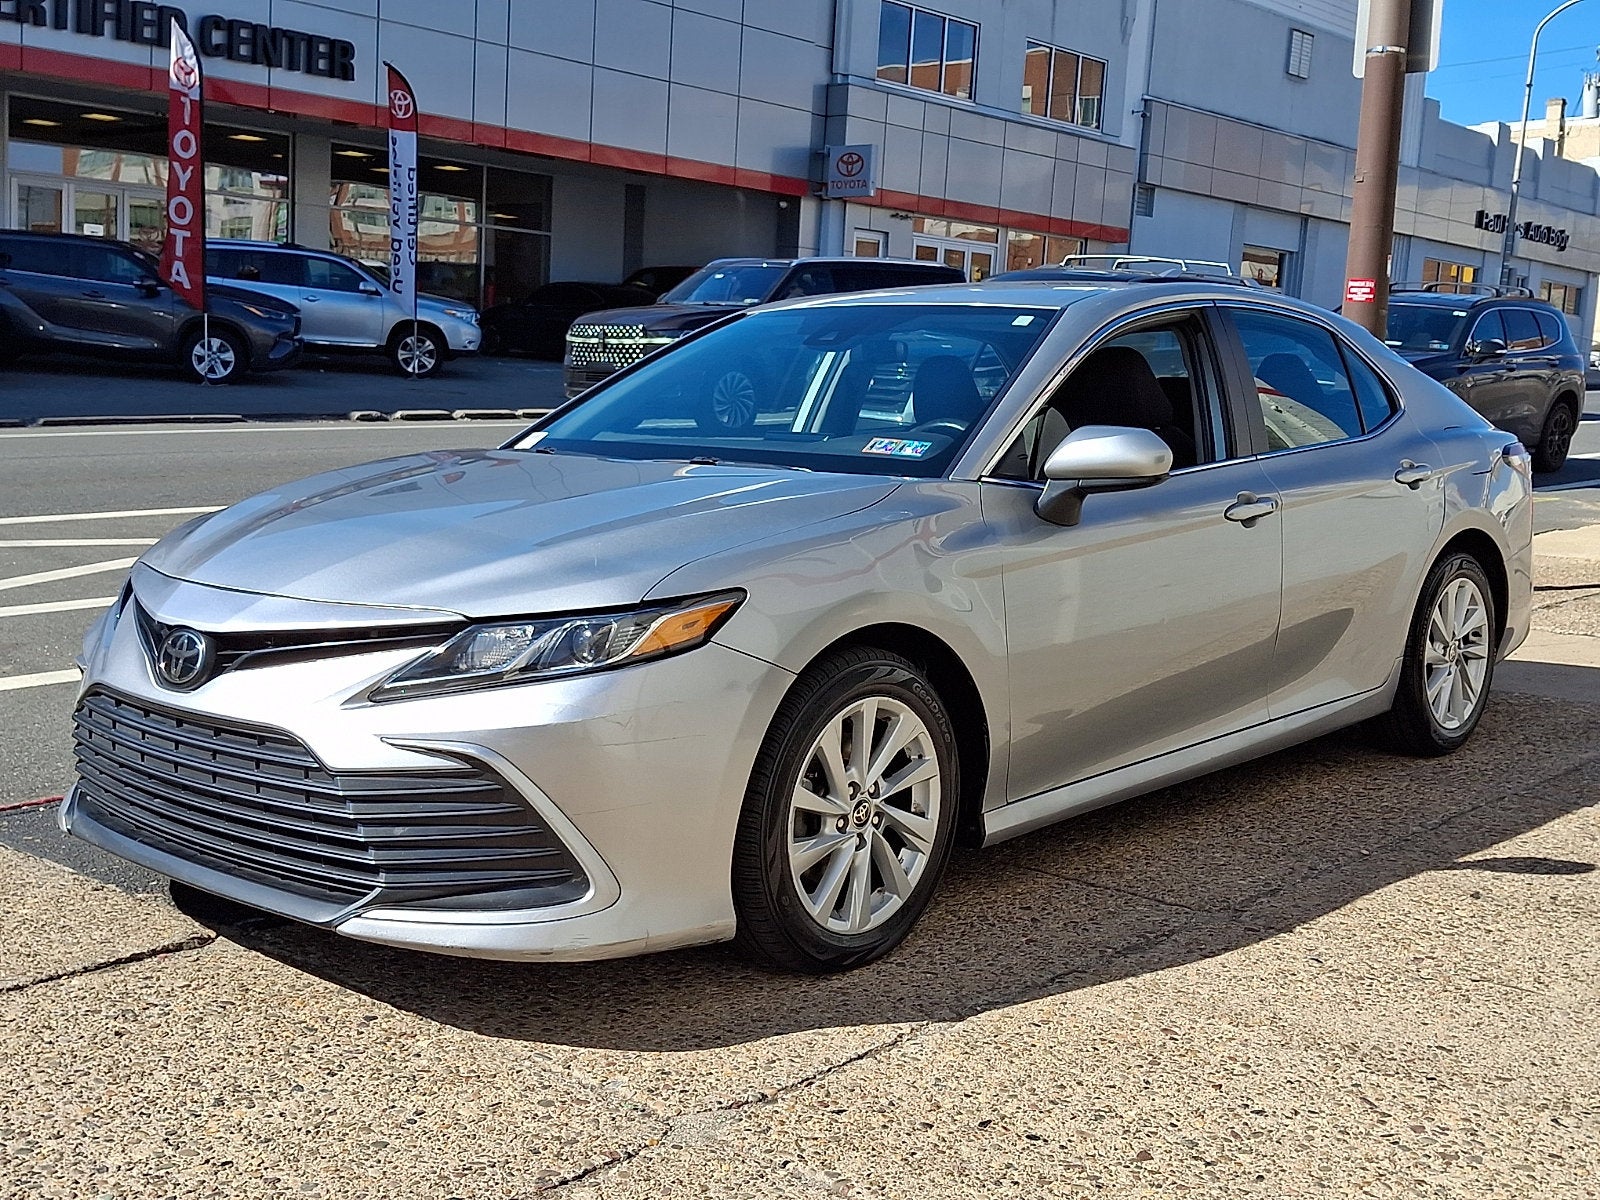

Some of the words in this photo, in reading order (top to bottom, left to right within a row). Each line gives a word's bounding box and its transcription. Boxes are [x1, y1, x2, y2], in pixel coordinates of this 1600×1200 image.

[200, 15, 355, 81] CENTER
[168, 96, 198, 289] TOYOTA
[831, 180, 867, 190] TOYOTA
[1475, 210, 1506, 234] Paul
[1525, 222, 1550, 244] Auto
[1548, 229, 1570, 252] Body
